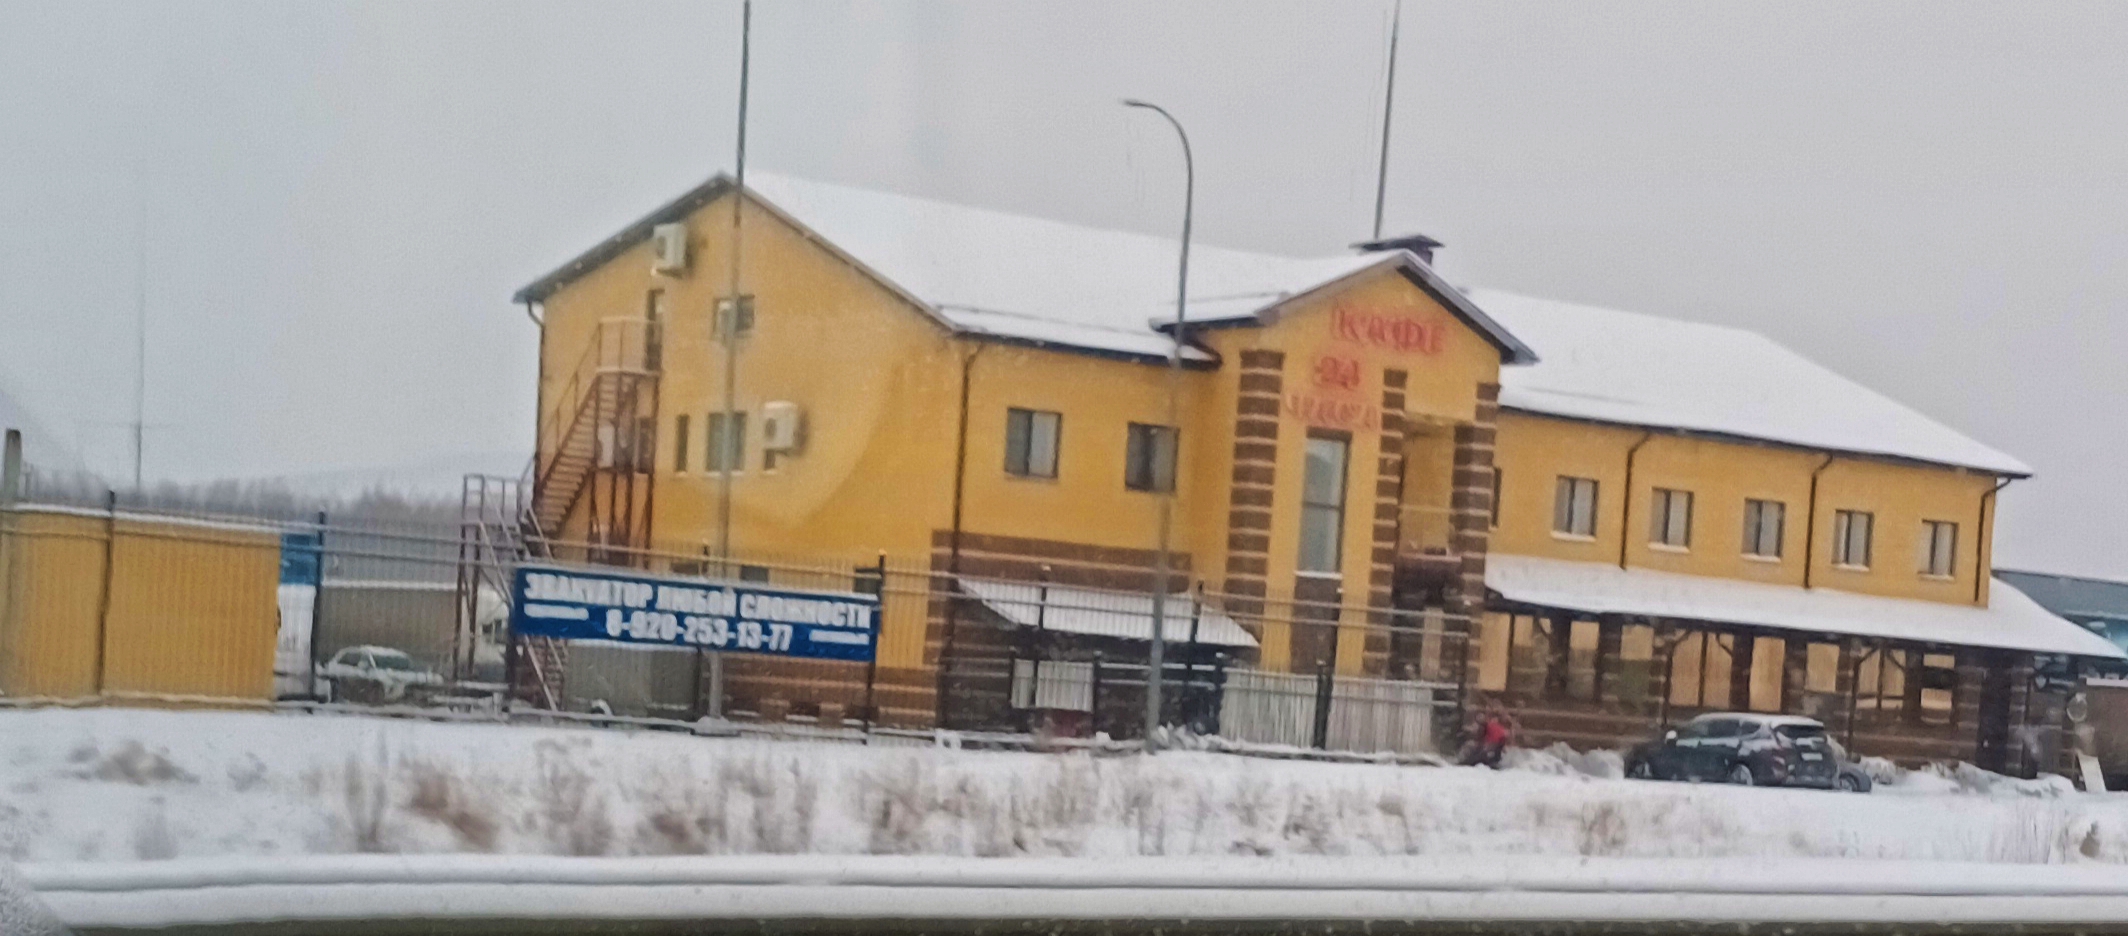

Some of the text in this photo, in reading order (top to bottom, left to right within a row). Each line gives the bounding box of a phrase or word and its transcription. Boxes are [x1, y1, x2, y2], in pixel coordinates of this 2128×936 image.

[1331, 307, 1445, 355] КАФЕ
[524, 573, 871, 629] ЭВАКУАТОР ЛЮБОЙ СЛОЖНОСТИ
